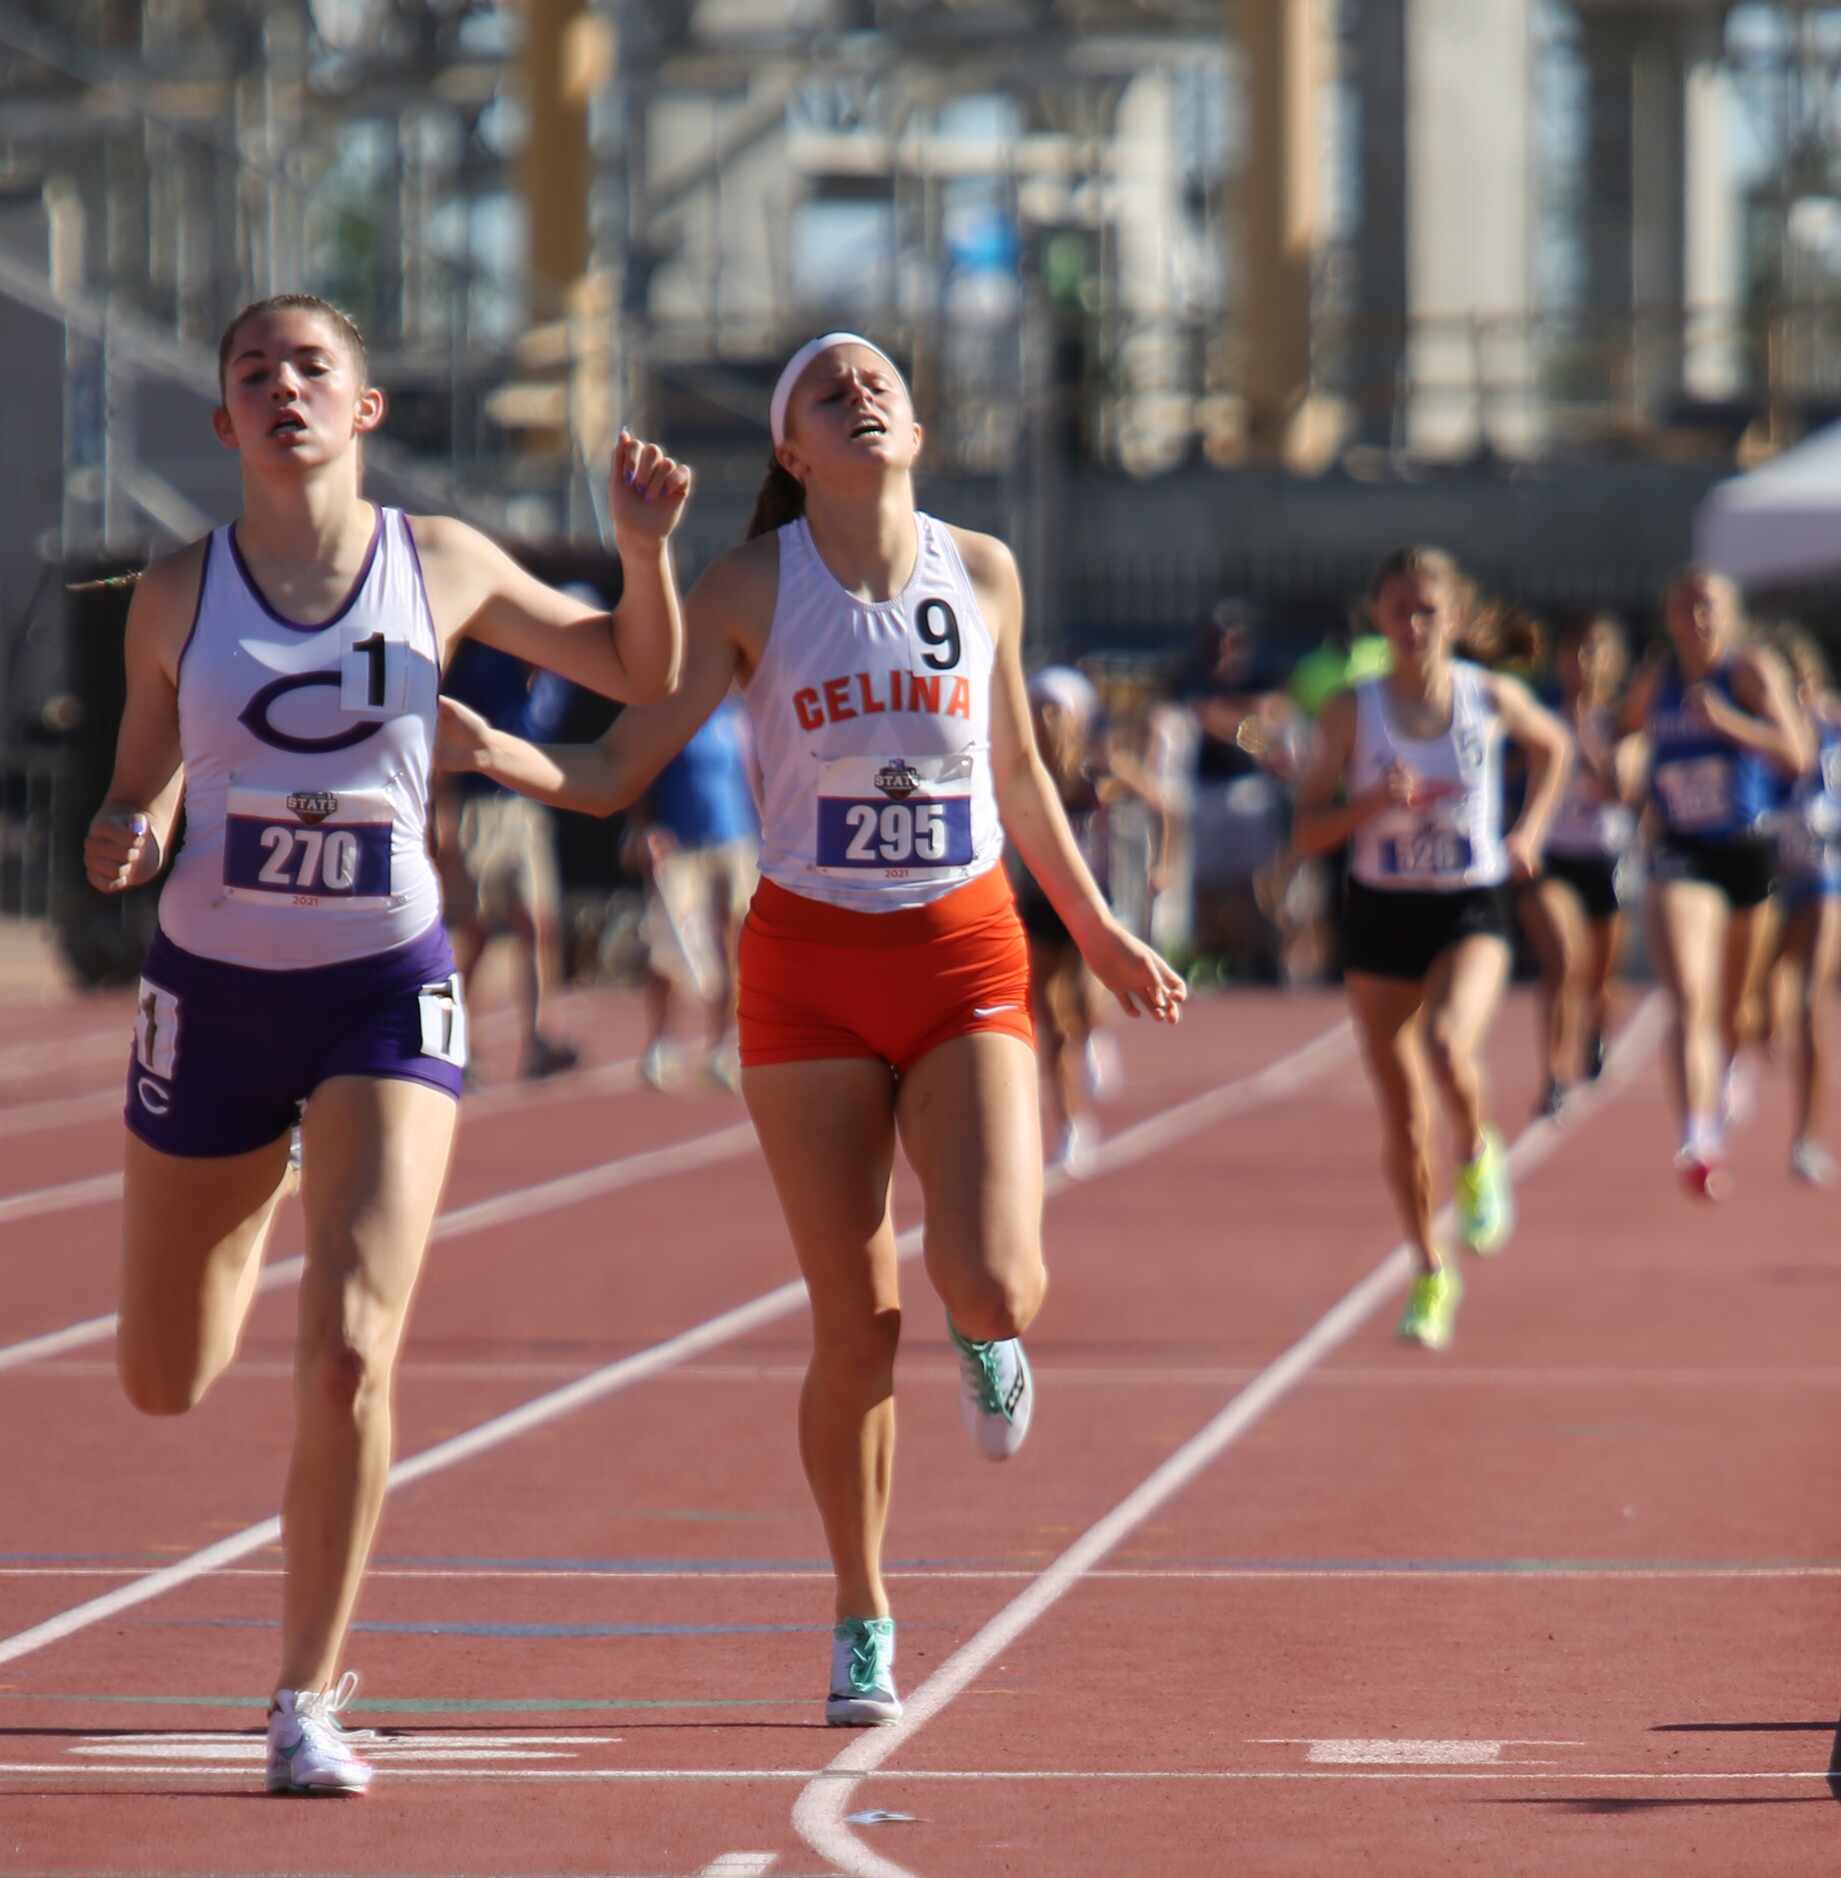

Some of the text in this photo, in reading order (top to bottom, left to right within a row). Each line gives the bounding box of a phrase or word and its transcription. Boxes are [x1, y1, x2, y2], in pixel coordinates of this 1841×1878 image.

[915, 598, 962, 671] 9
[353, 632, 386, 708] 1
[793, 669, 971, 732] CELINA
[238, 670, 384, 754] C
[287, 796, 337, 811] STATE
[845, 804, 946, 862] 295
[258, 826, 361, 889] 270
[884, 869, 910, 879] 2021
[292, 895, 320, 908] 2021
